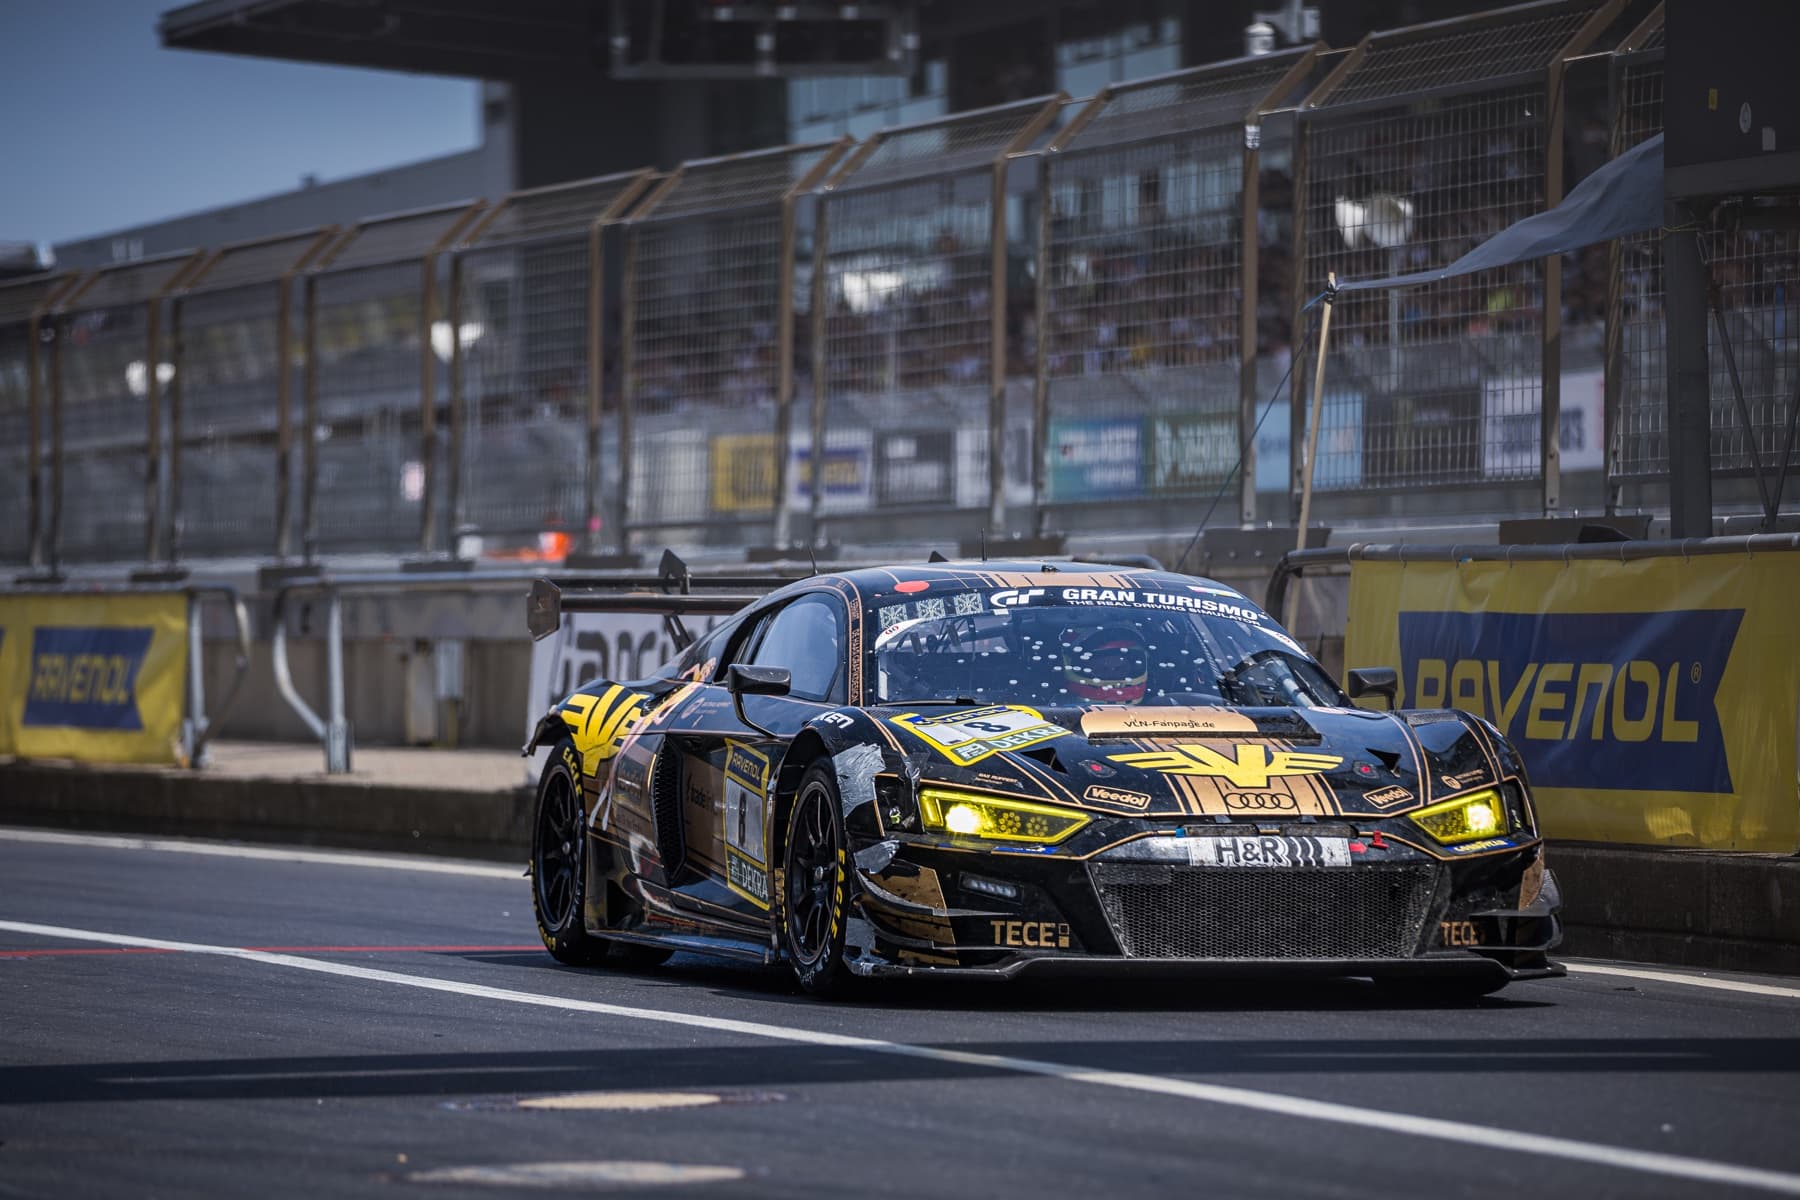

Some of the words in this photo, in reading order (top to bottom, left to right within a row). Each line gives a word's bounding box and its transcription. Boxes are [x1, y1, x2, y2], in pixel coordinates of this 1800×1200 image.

[1062, 589, 1135, 602] GRAN
[1133, 602, 1186, 612] DRIVING
[1188, 608, 1261, 626] SIMULATOR
[963, 721, 1011, 733] 8
[1124, 719, 1215, 729] VLN-Fanpage.de
[986, 725, 1068, 749] DEKRA
[732, 752, 761, 781] RAVENOL
[1091, 788, 1145, 807] Veedol
[1215, 837, 1284, 863] H&R
[741, 862, 768, 898] DEKRA
[830, 848, 846, 939] EAGLE
[990, 920, 1056, 947] TECE
